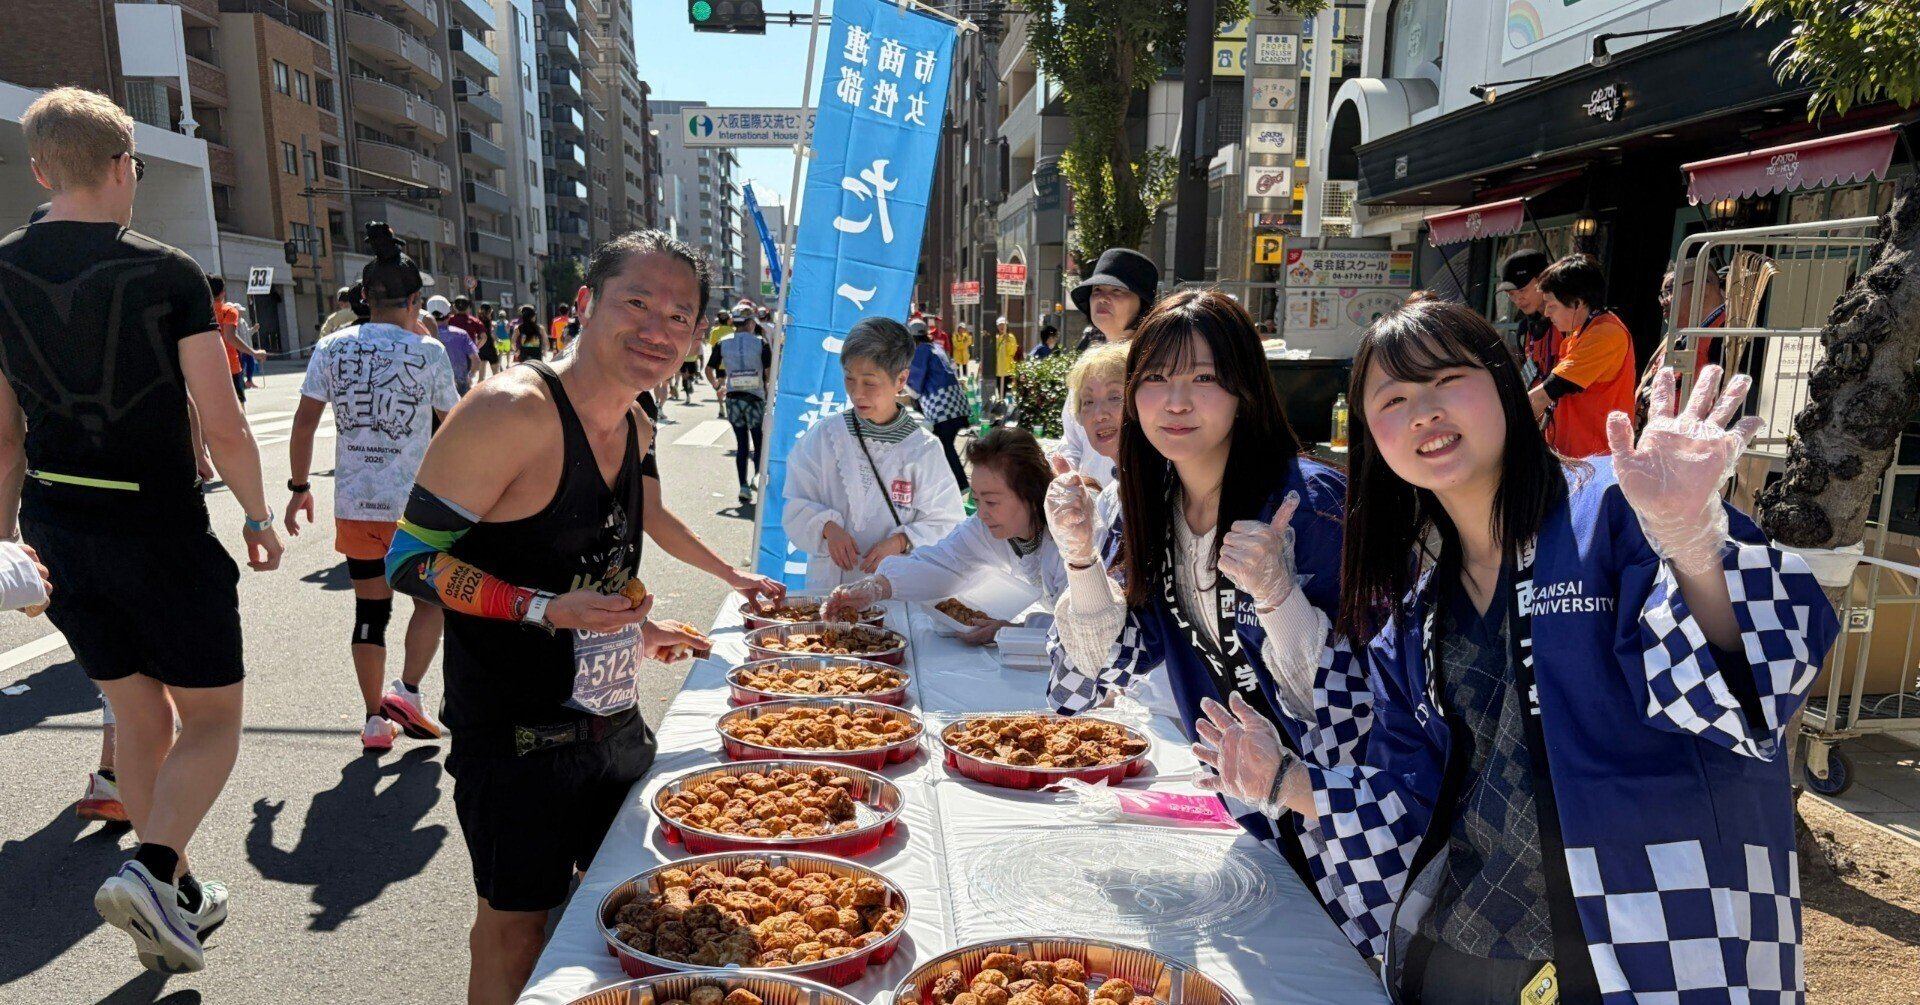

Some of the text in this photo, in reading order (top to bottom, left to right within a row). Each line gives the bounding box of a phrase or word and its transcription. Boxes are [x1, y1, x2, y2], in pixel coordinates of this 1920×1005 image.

[719, 131, 769, 140] International
[773, 130, 799, 140] House
[1263, 238, 1279, 261] P
[1313, 260, 1388, 271] 英会話スクール
[251, 269, 267, 287] 33
[367, 446, 402, 454] MARATHON
[446, 565, 466, 596] OSAKA
[453, 567, 471, 599] MARATHON
[461, 571, 484, 604] 2026
